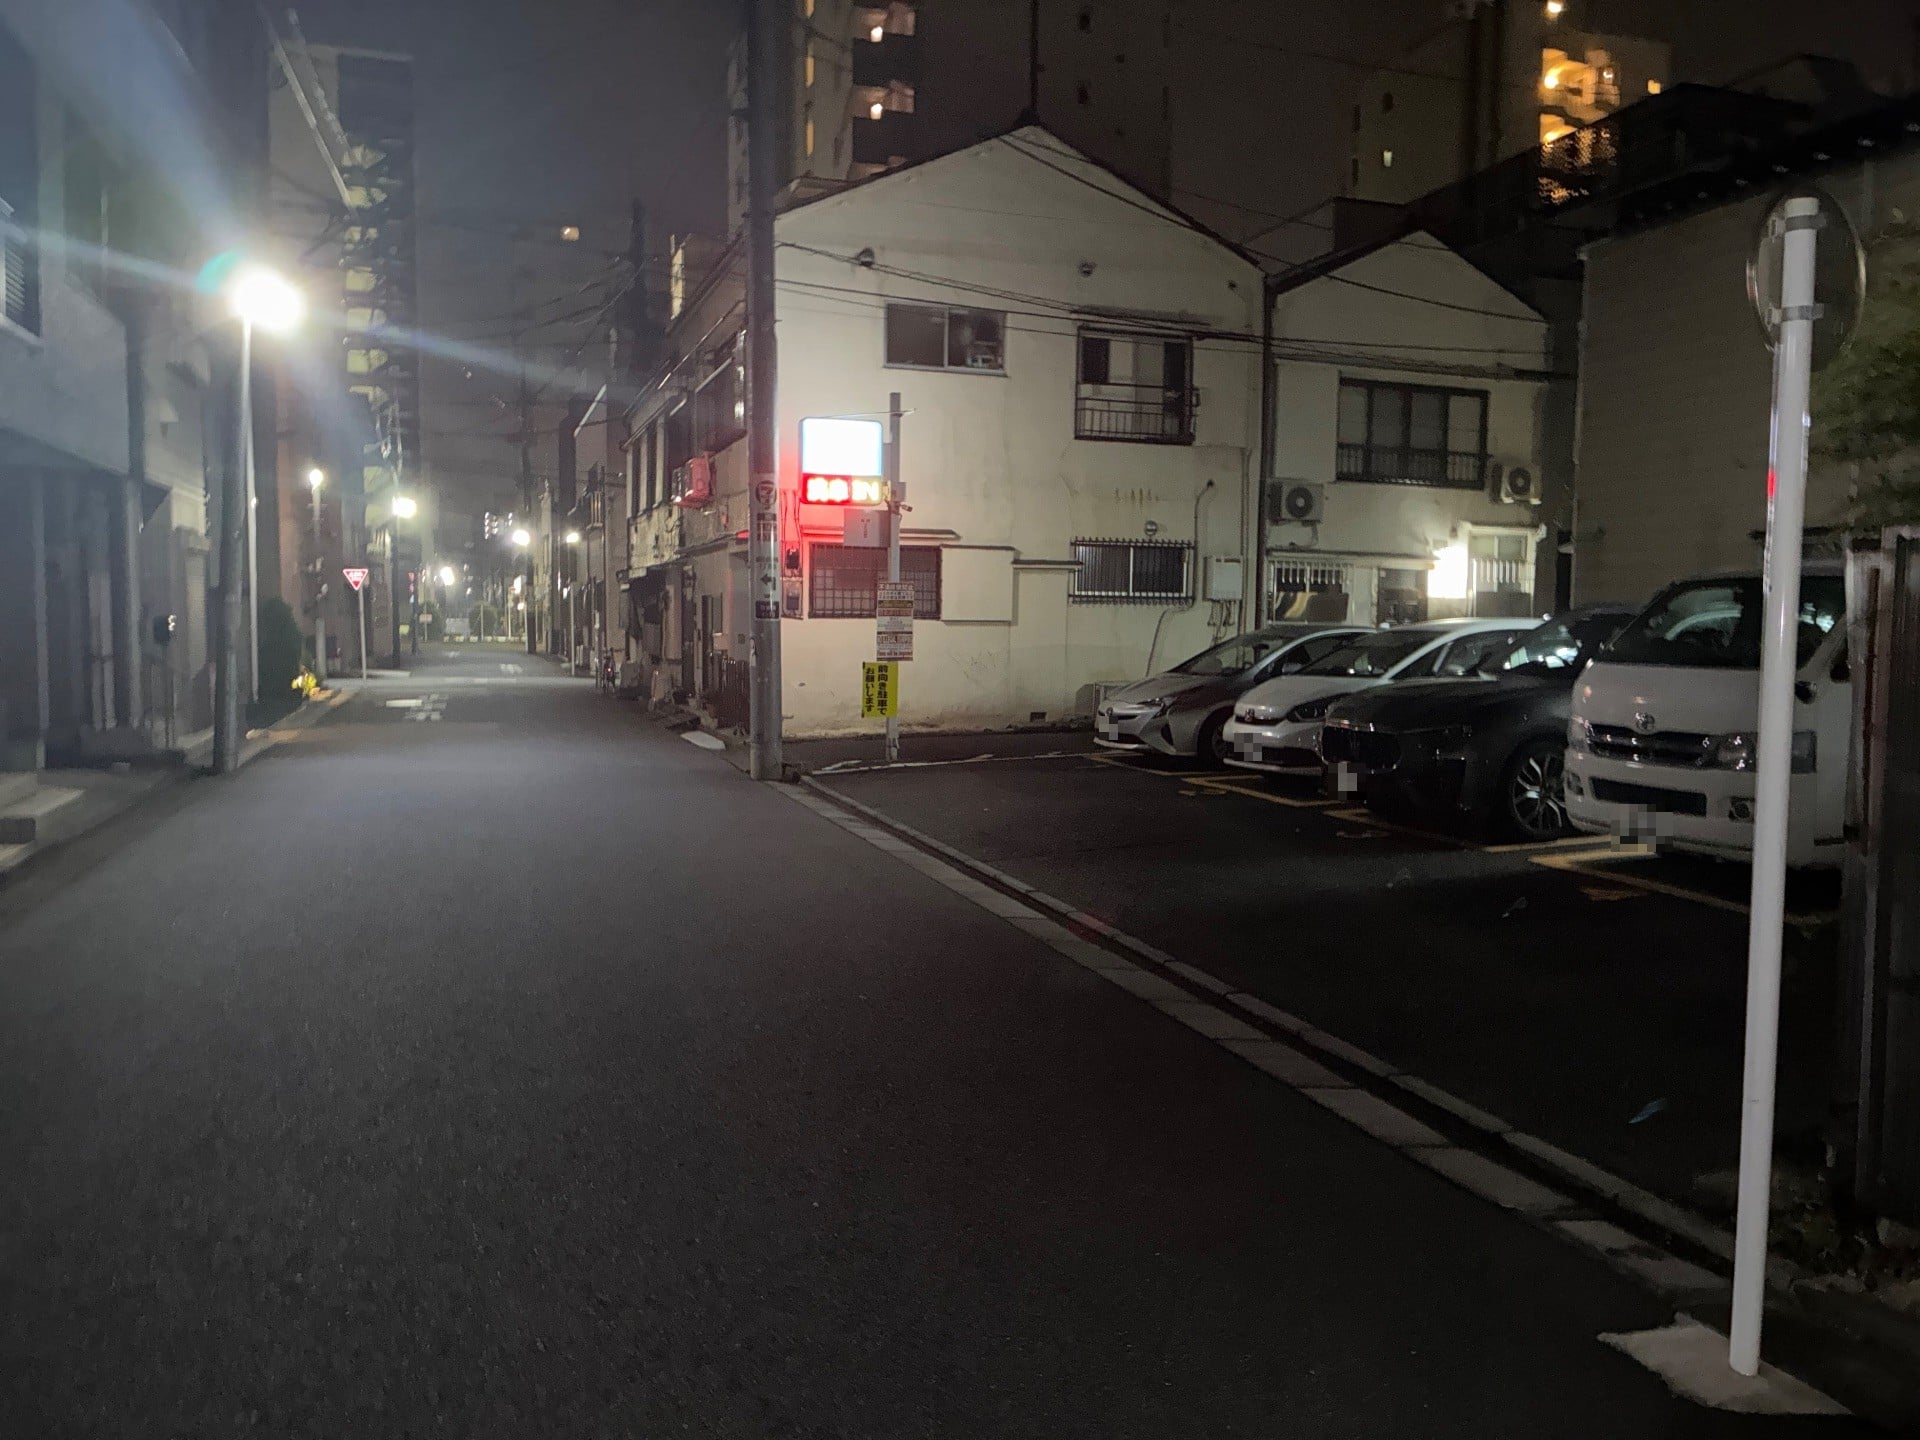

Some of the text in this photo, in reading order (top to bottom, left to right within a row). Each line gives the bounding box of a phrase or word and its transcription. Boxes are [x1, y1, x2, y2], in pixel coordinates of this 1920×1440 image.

[864, 667, 875, 713] お願いします
[877, 664, 889, 716] 前向き駐車で
